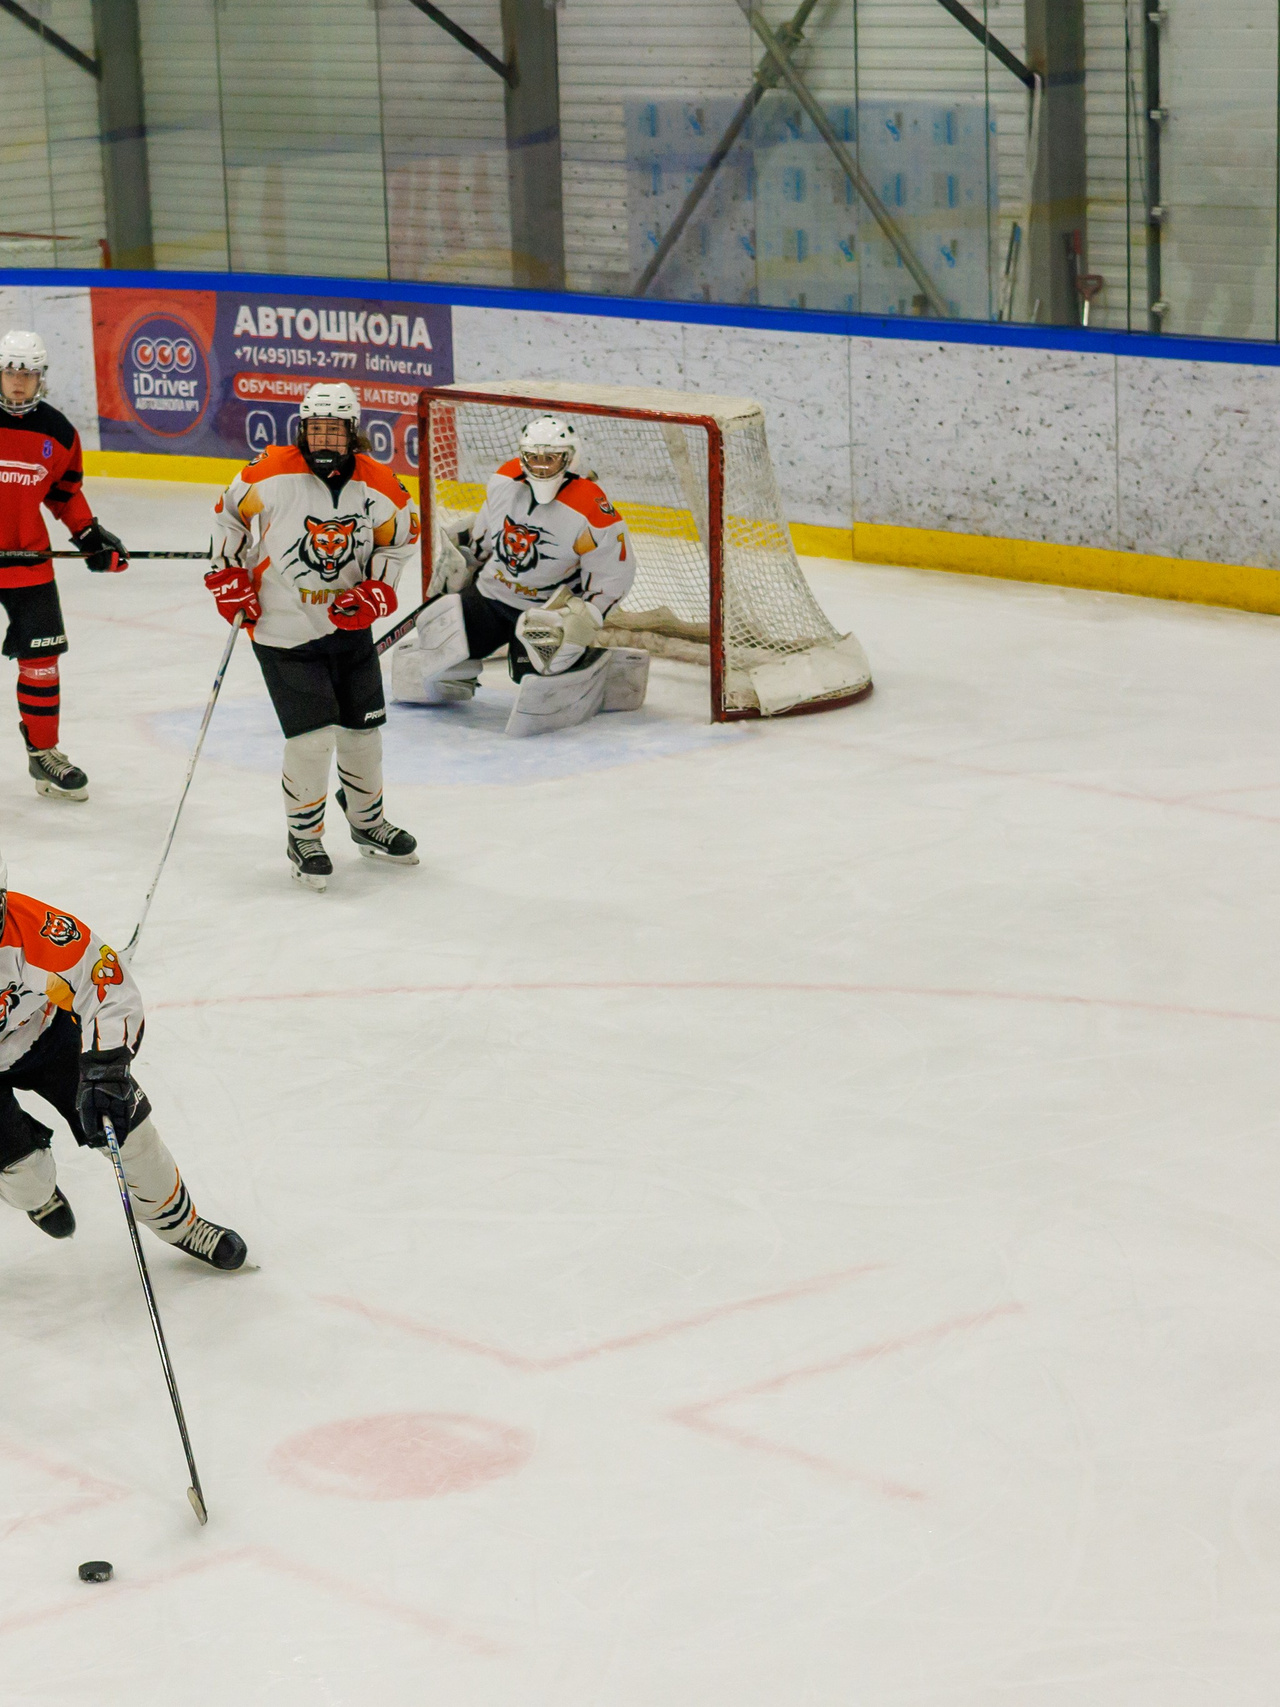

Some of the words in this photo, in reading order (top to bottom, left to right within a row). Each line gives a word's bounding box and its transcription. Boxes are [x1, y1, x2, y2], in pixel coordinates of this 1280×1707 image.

[234, 305, 433, 351] АВТОШКОЛА
[234, 347, 358, 370] +7(495)151-2-777
[365, 351, 433, 377] idriver.ru
[133, 373, 199, 398] iDriver
[254, 422, 269, 442] A
[374, 432, 388, 452] D
